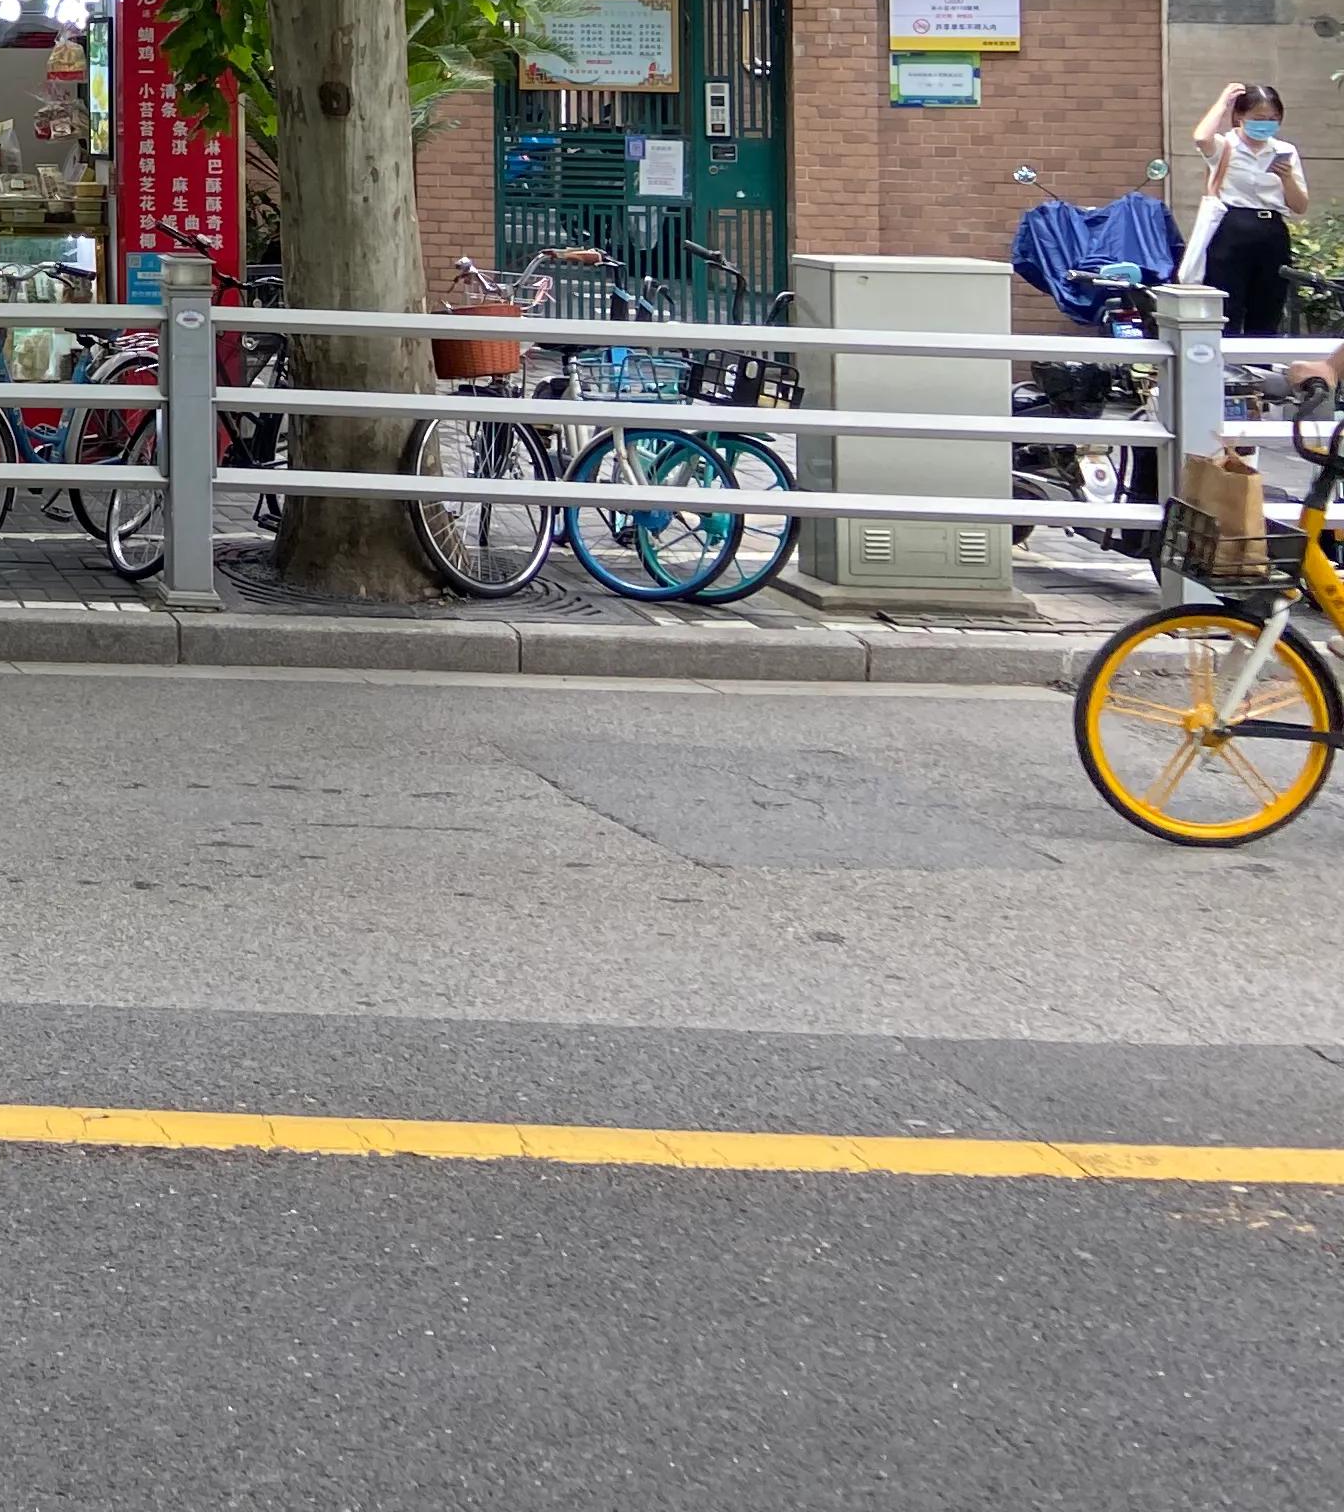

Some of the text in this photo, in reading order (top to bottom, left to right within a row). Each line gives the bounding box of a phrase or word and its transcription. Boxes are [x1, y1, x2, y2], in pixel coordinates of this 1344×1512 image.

[138, 177, 223, 194] 芝麻酥
[138, 196, 223, 213] 花生酥
